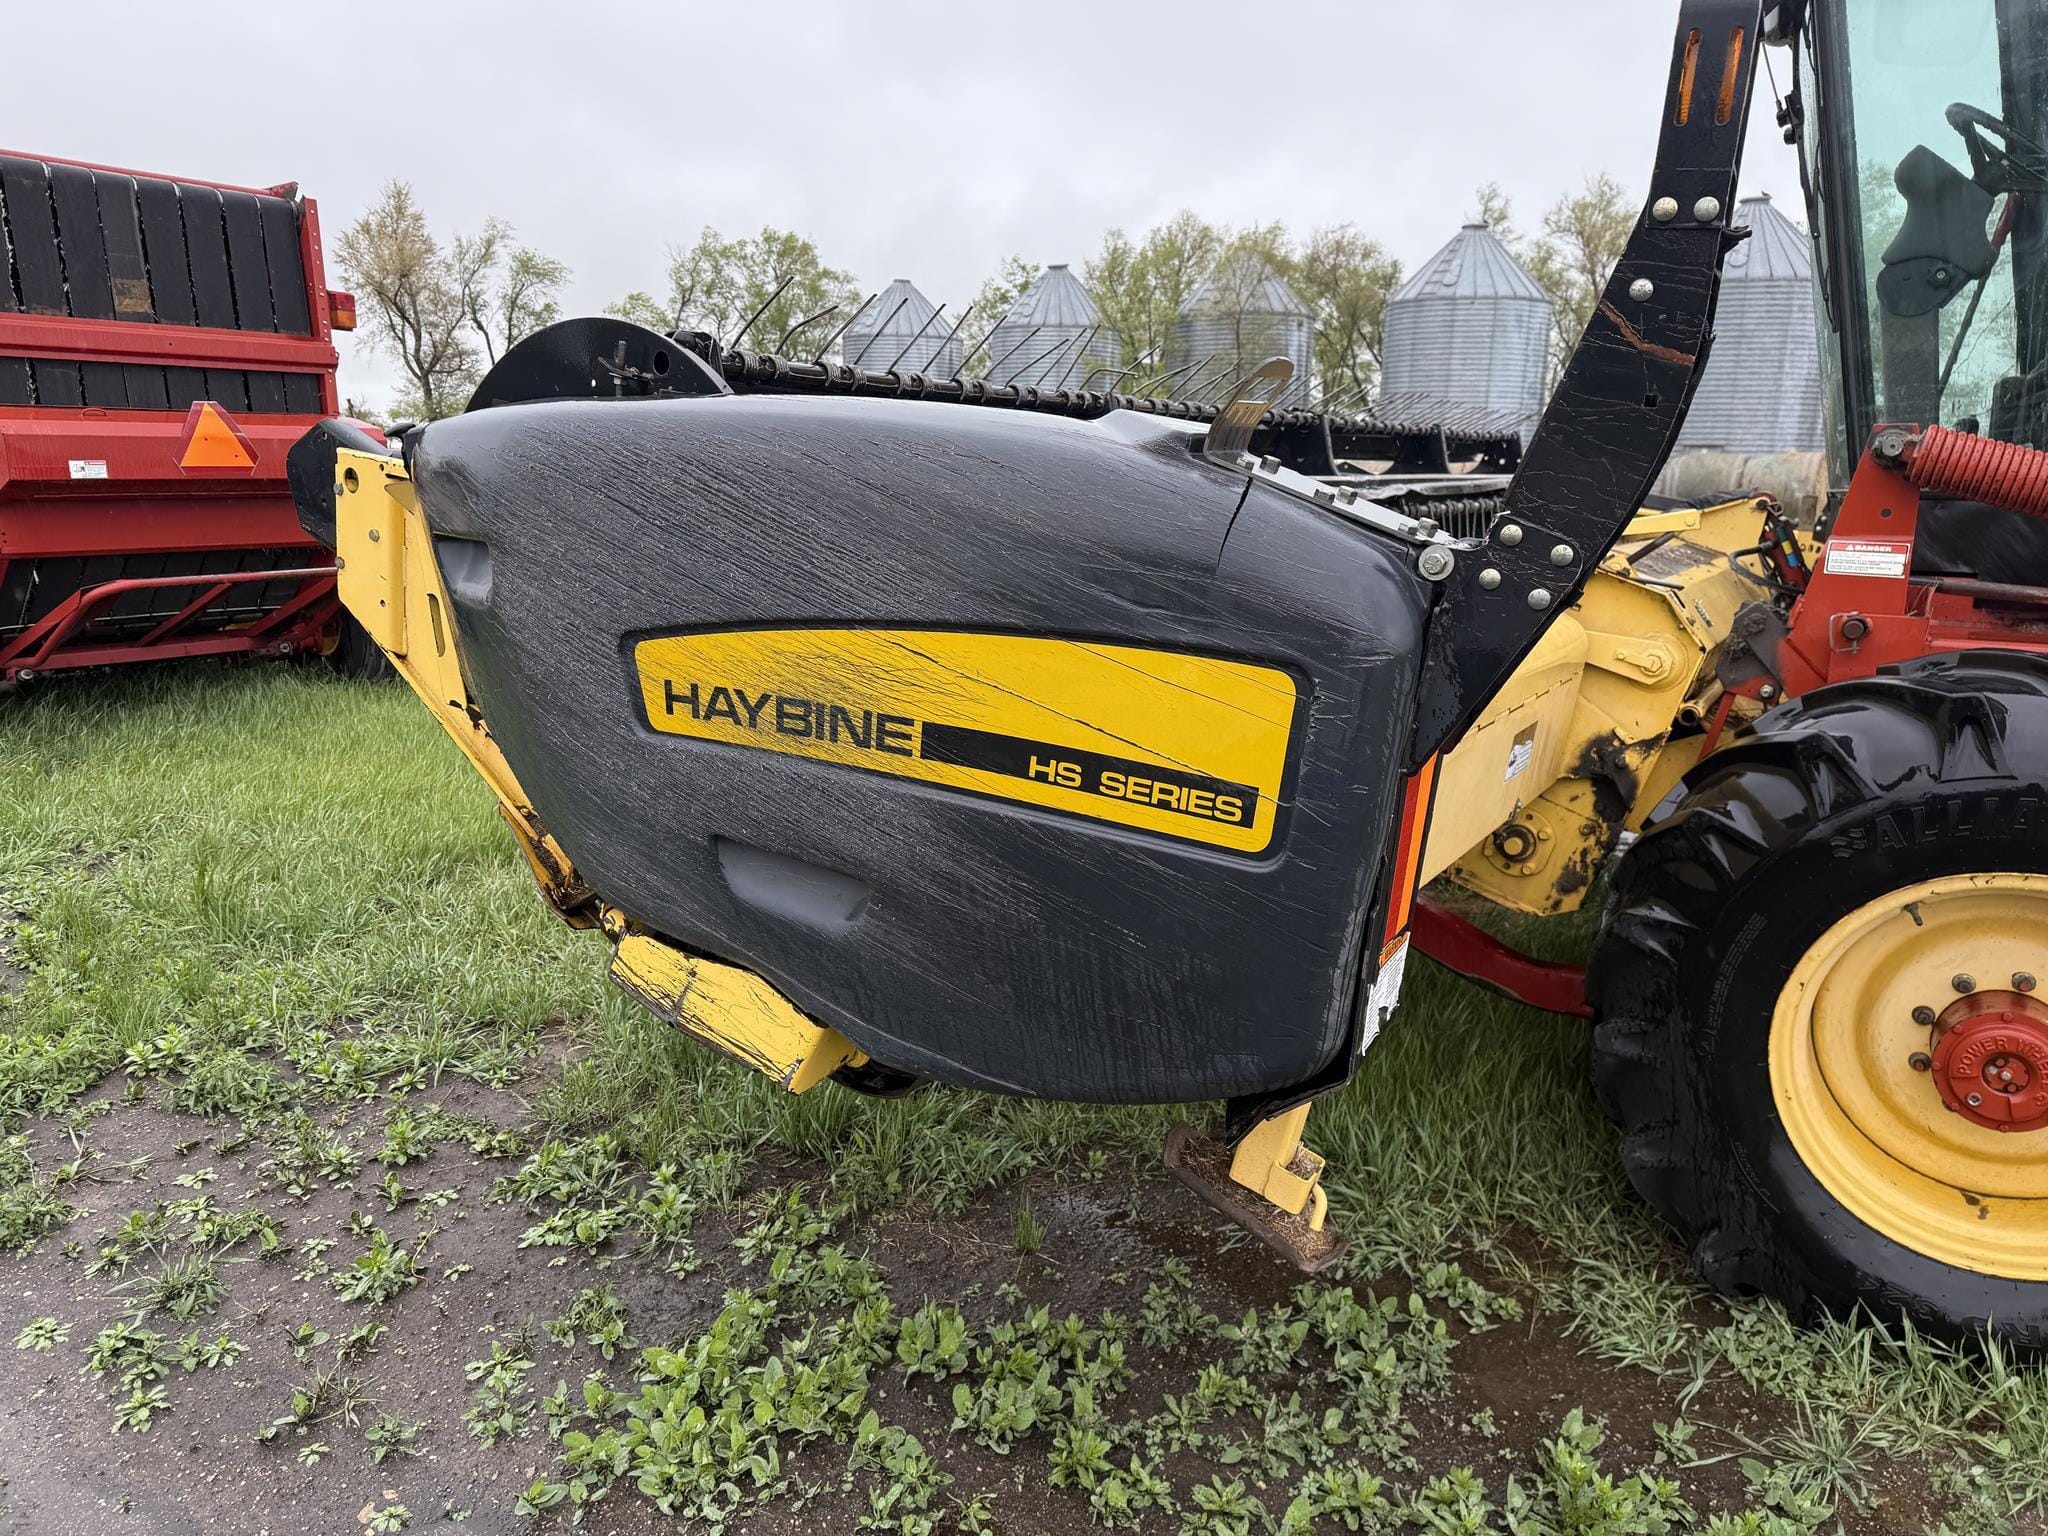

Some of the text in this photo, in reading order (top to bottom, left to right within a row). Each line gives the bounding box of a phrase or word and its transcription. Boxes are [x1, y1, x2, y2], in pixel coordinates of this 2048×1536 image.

[1855, 544, 1892, 552] DANGER
[664, 679, 915, 757] HAYBINE
[1028, 755, 1243, 822] HS SERIES
[1957, 1036, 2008, 1075] POWER
